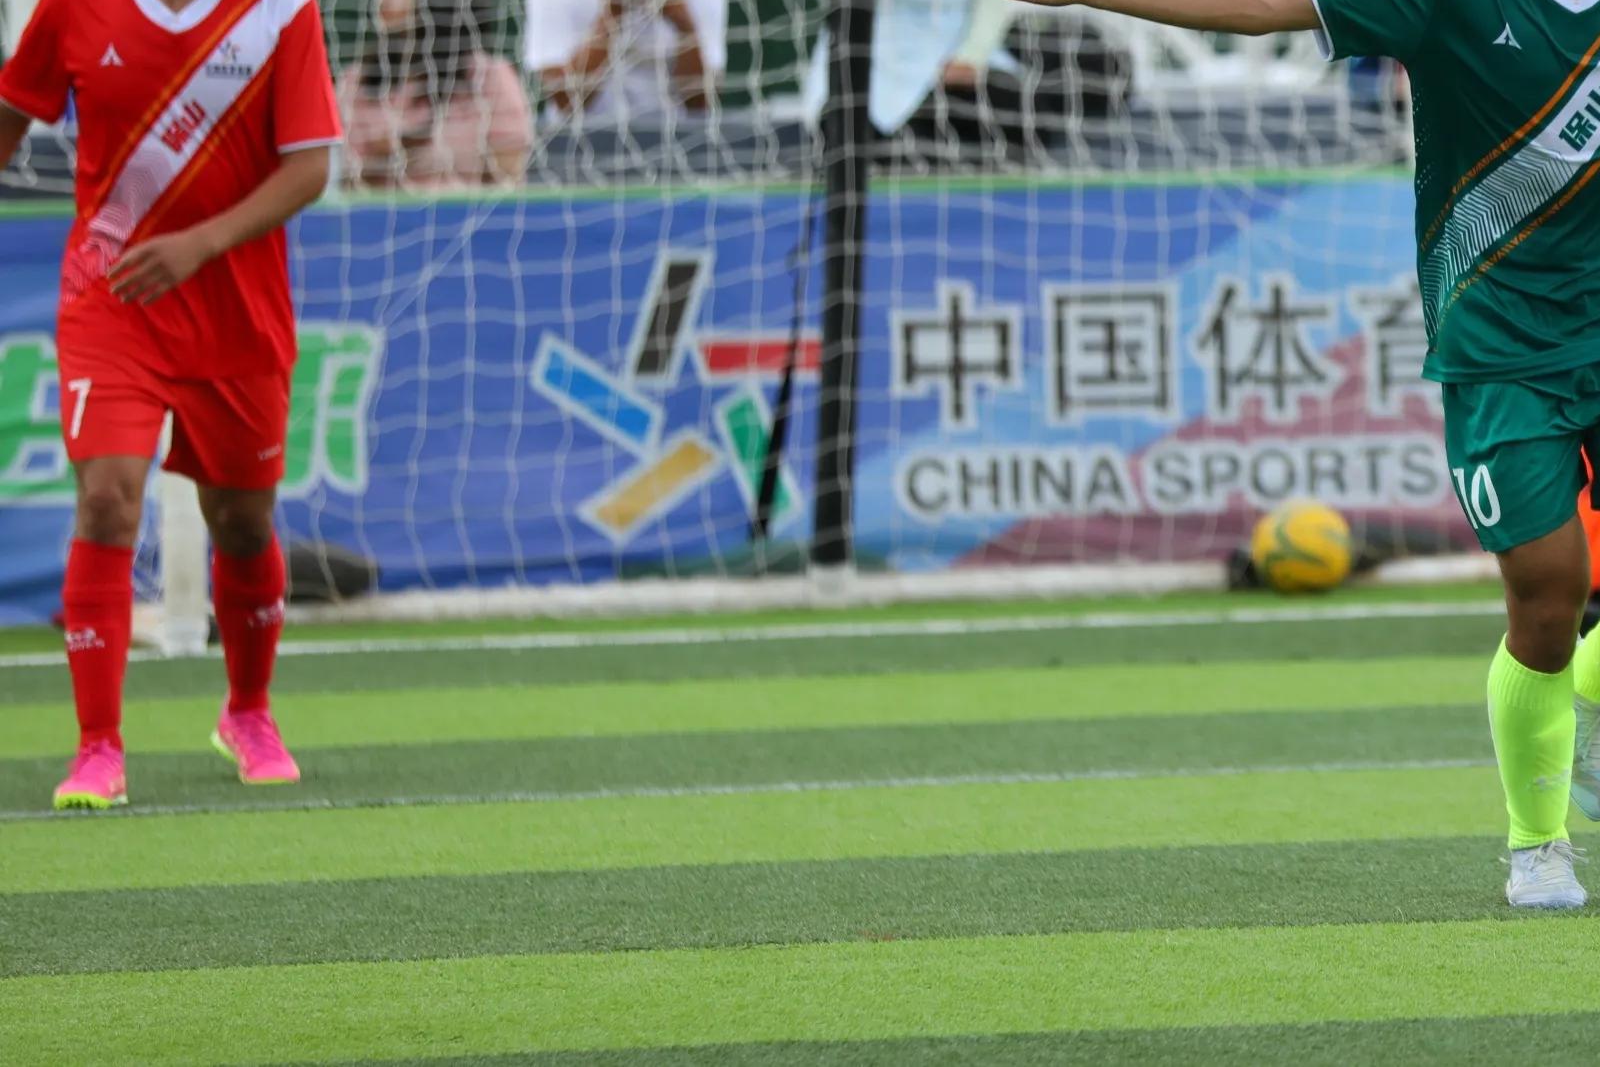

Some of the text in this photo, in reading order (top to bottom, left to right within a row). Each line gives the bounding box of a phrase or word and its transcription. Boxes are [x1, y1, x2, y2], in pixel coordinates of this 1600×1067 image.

[68, 378, 92, 440] 7
[904, 441, 1440, 518] CHINA SPORTS
[1452, 464, 1501, 530] 10
